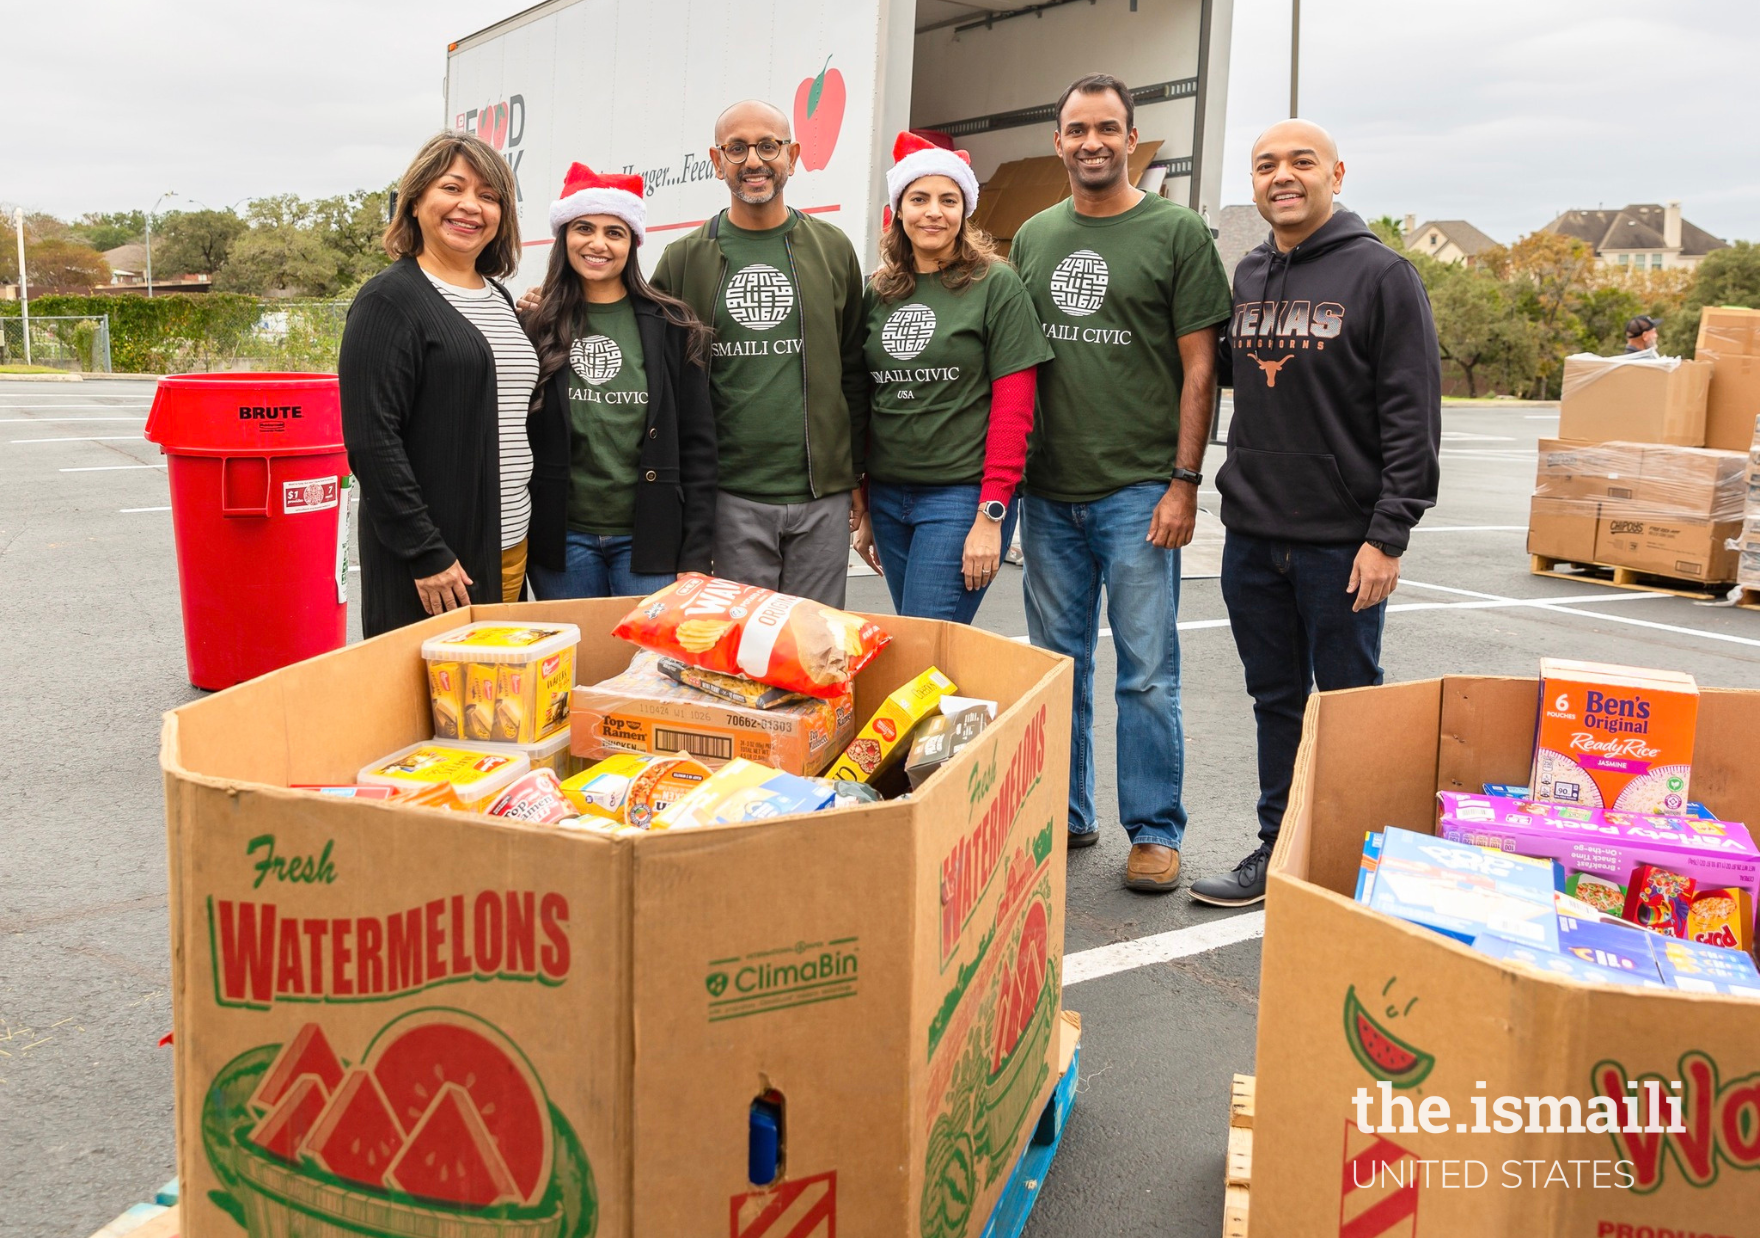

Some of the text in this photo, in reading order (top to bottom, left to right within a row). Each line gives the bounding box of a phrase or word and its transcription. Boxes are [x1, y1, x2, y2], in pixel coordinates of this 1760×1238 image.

[1232, 300, 1346, 339] TEXAS
[1083, 328, 1132, 345] CIVIC
[915, 366, 960, 382] CIVIC
[605, 391, 649, 404] CIVIC
[897, 390, 915, 400] USA
[239, 406, 303, 419] BRUTE
[1555, 693, 1569, 711] 6
[1585, 690, 1650, 719] Ben's
[640, 704, 669, 715] 110424
[690, 711, 711, 721] 1026
[1547, 711, 1576, 720] POUCHES
[602, 715, 625, 728] Top
[726, 714, 792, 732] 70662-01303
[1584, 714, 1649, 734] Original
[603, 726, 647, 741] Ramen
[1597, 759, 1627, 769] JASMINE
[967, 738, 998, 825] Fresh
[521, 795, 552, 821] amen
[941, 703, 1047, 960] WATERMELONS
[1543, 817, 1620, 836] Pack
[1627, 827, 1747, 850] Variety
[1571, 852, 1617, 863] Snack Time
[1573, 844, 1617, 856] On-the-go
[246, 833, 338, 889] Fresh
[1576, 860, 1616, 871] Breakfast
[218, 889, 571, 1002] WATERMELONS
[735, 951, 858, 993] ClimaBin
